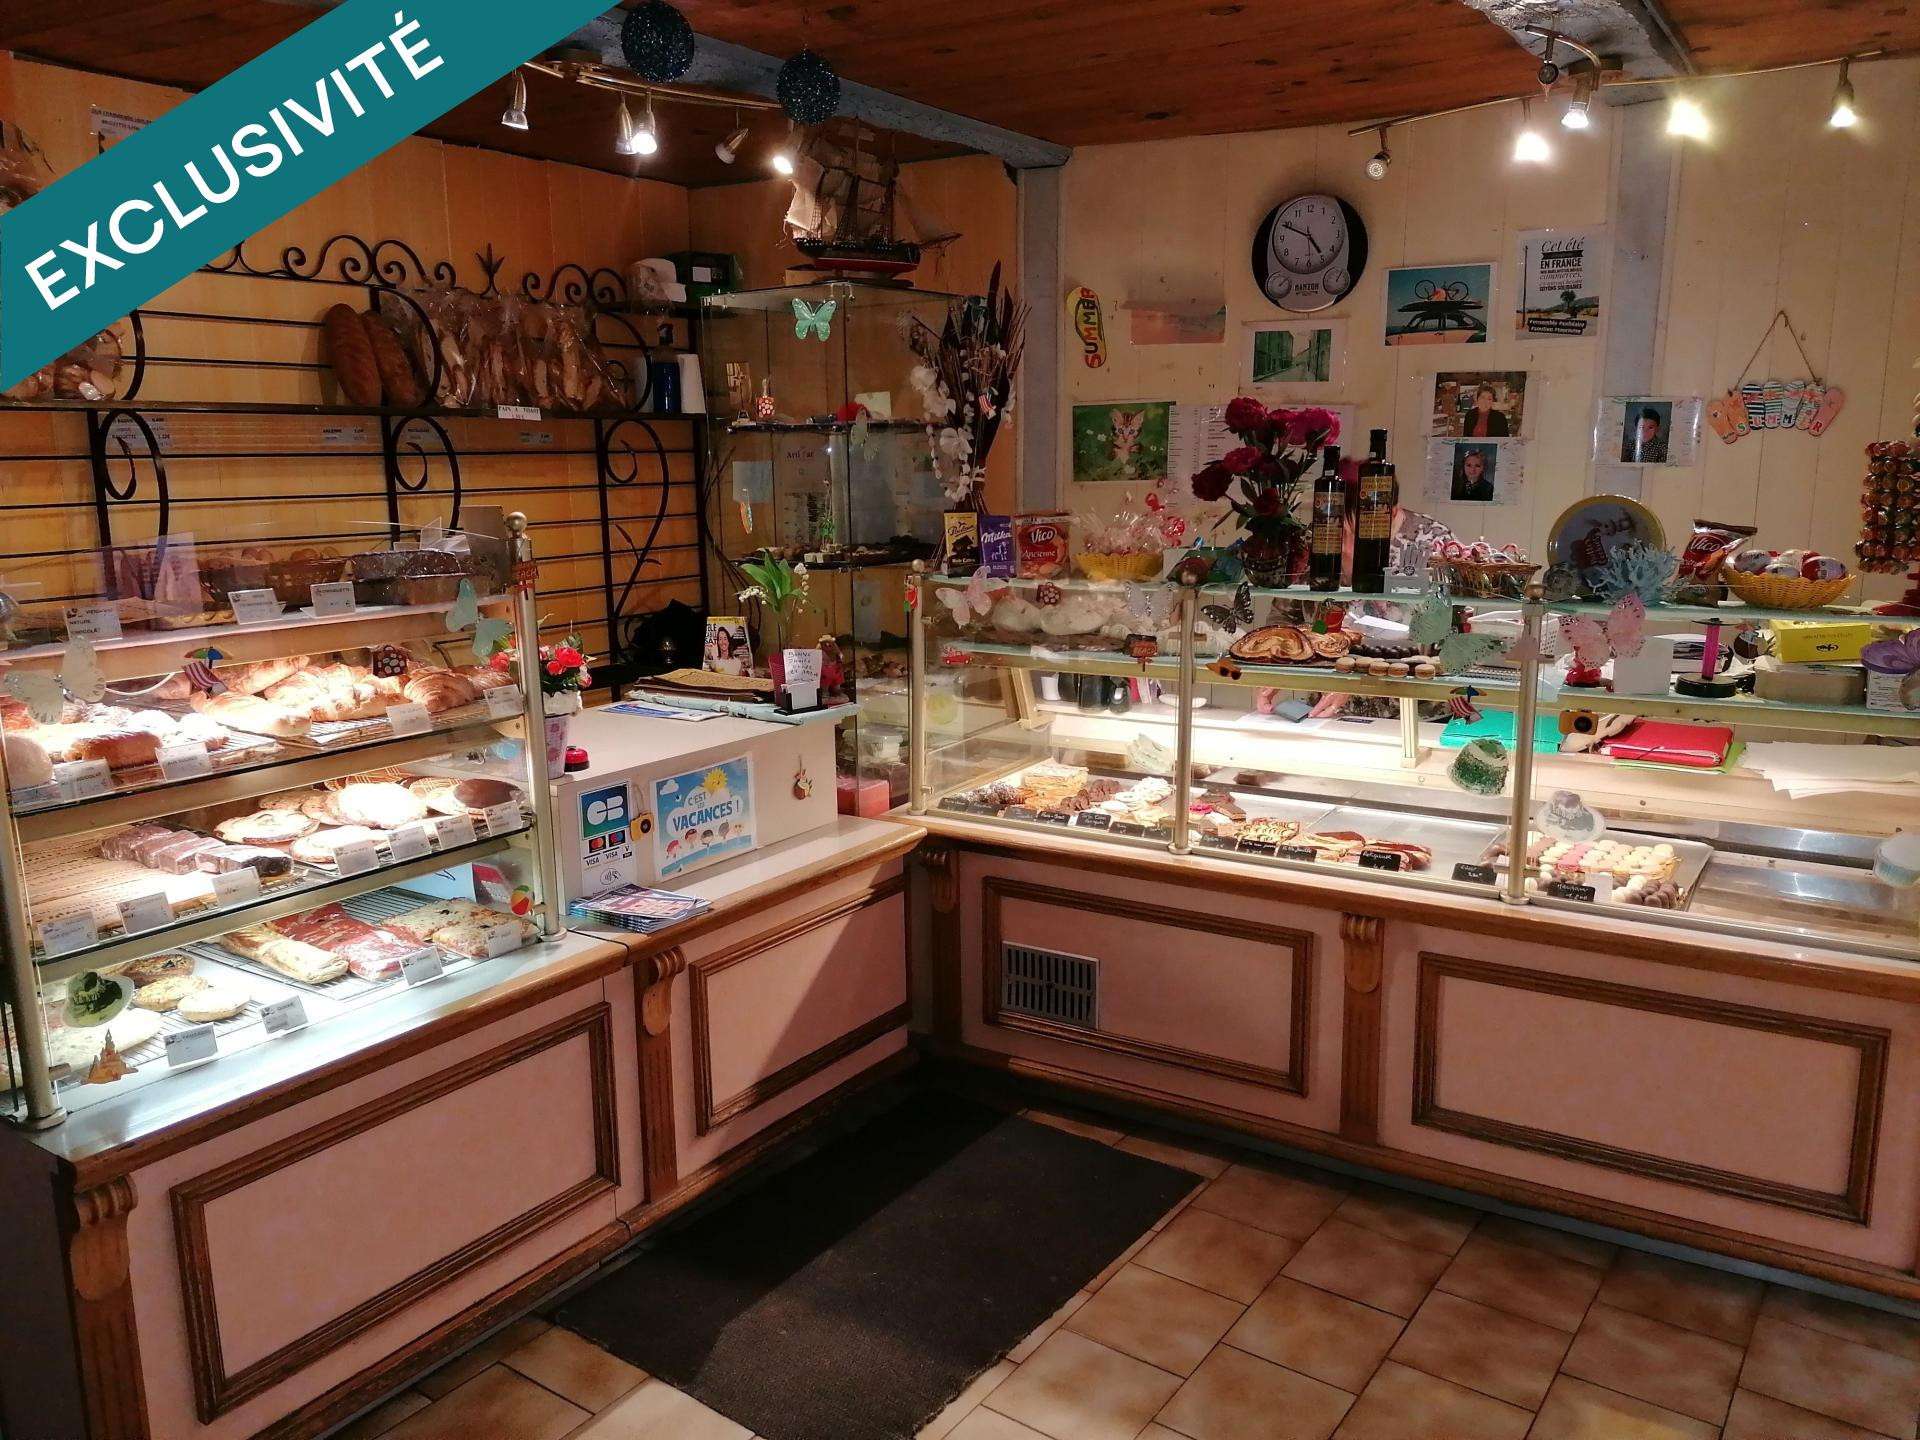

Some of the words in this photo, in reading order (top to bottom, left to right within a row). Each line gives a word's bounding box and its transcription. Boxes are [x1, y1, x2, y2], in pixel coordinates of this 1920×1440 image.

[1540, 260, 1550, 269] EN
[1552, 258, 1582, 268] FRANCE
[981, 530, 1012, 543] Milka
[1031, 528, 1054, 544] Vico
[1690, 537, 1720, 551] Vico
[687, 791, 707, 806] C'EST
[672, 800, 733, 832] VACANCES
[585, 856, 600, 867] VISA
[605, 851, 618, 860] VISA
